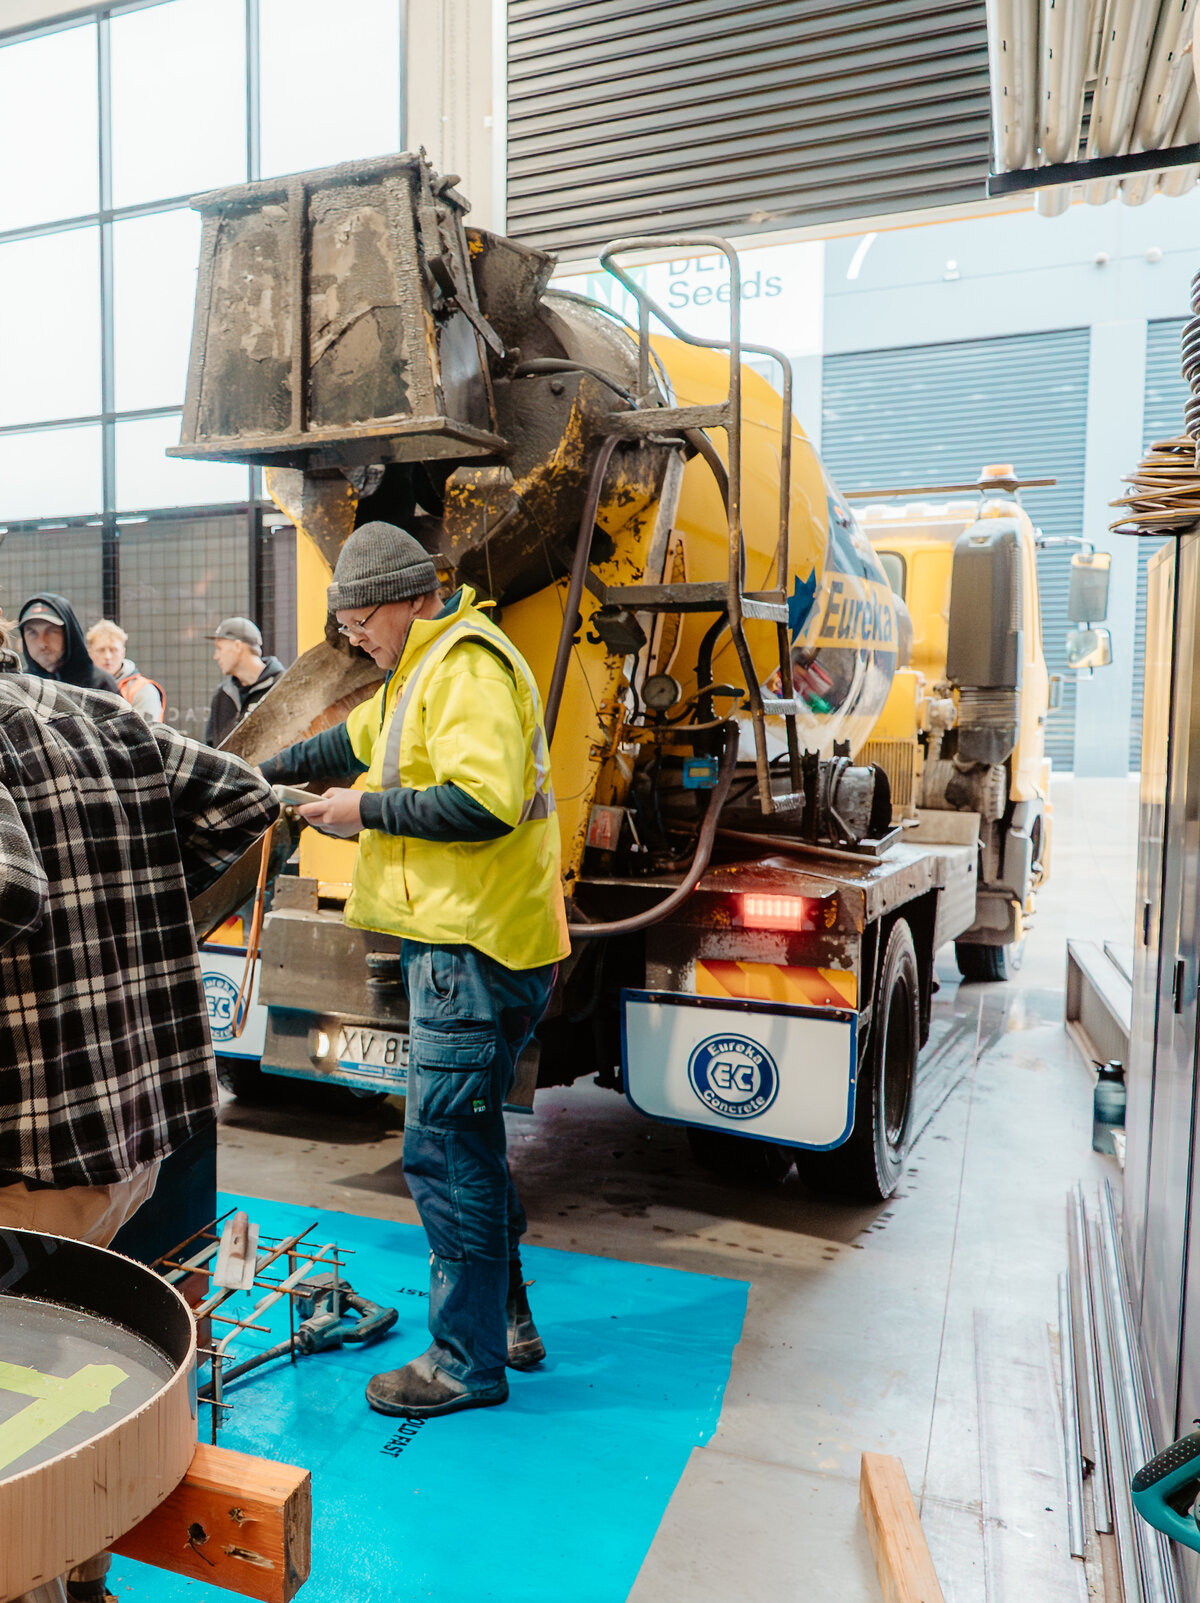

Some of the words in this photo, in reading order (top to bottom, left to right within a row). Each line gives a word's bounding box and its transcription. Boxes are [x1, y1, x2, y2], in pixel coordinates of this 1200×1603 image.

[668, 270, 783, 309] Seeds
[818, 580, 893, 643] Eureka
[339, 1027, 375, 1061] XV
[706, 1041, 763, 1065] Eureka
[710, 1061, 754, 1093] EC
[703, 1088, 767, 1115] Concrete
[397, 1416, 429, 1436] OLD
[379, 1434, 413, 1459] FAST
